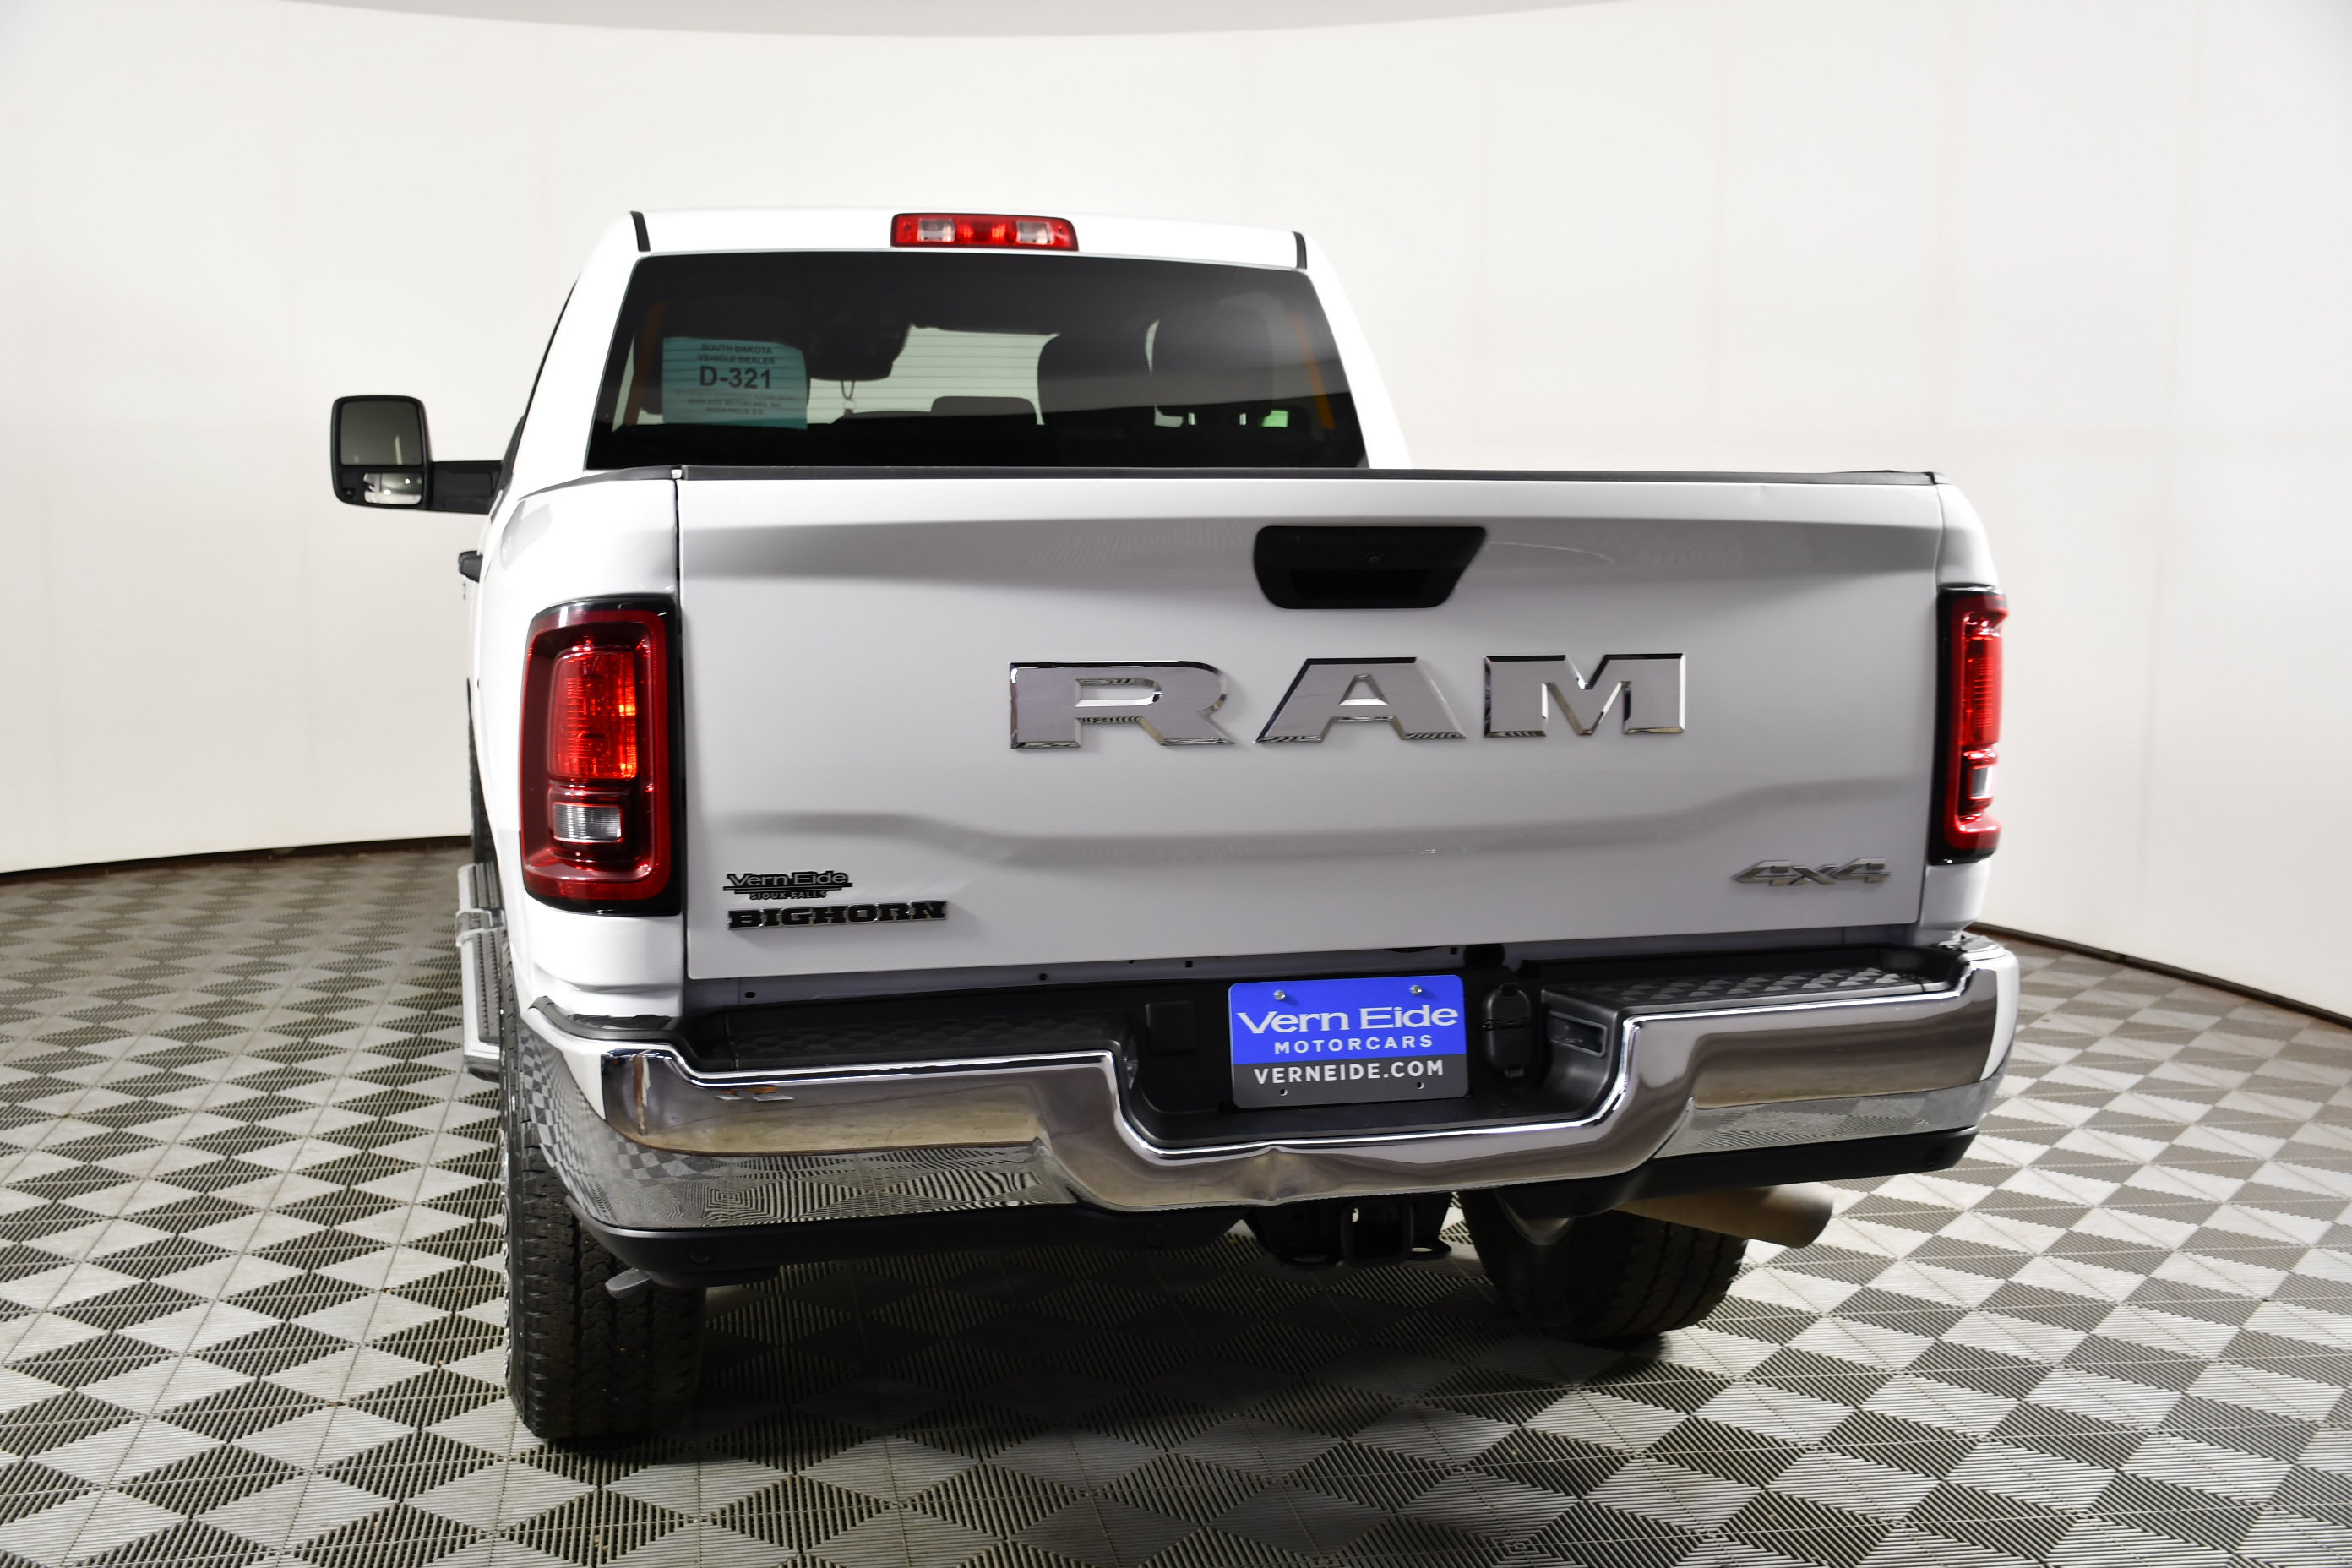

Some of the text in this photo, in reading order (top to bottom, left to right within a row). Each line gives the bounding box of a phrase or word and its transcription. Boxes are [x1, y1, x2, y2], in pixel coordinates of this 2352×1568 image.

[700, 366, 771, 389] D-321
[1009, 652, 1687, 749] RAM
[727, 871, 849, 887] Vern Eide
[749, 890, 827, 900] SIOUX FALLS
[727, 901, 947, 930] BIGHORN
[1237, 1004, 1459, 1034] Vern Eide
[1274, 1035, 1434, 1054] MOTORCARS
[1254, 1060, 1444, 1085] VERNEIDE.COM
